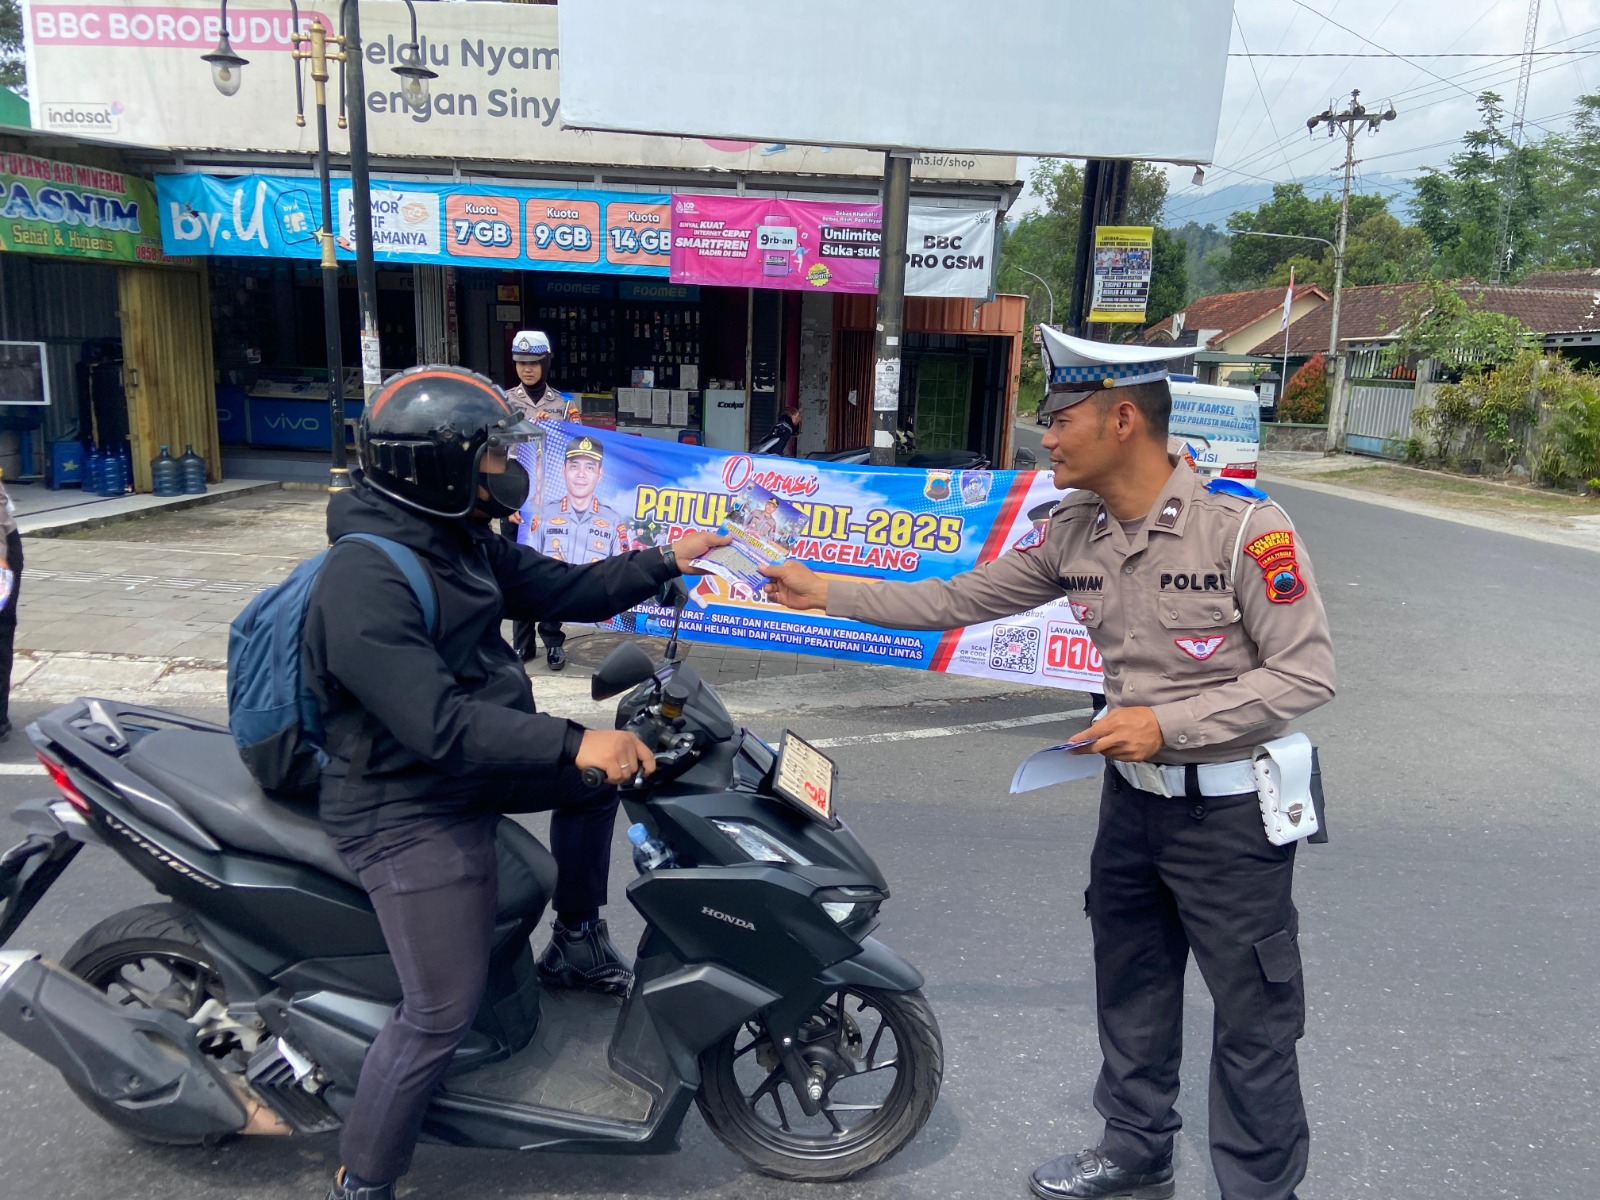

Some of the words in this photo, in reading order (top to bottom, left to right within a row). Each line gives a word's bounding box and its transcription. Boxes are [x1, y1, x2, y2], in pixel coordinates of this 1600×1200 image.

[37, 12, 100, 39] BBC
[361, 34, 449, 66] elalu
[366, 88, 477, 123] engan
[48, 107, 112, 124] indosat
[9, 154, 50, 180] ULANG
[54, 162, 74, 185] AIR
[77, 165, 126, 194] MINERAL
[348, 199, 399, 214] NMOR
[465, 203, 497, 215] Kuota
[547, 207, 579, 219] Kuota
[628, 211, 660, 223] Kuota
[699, 221, 725, 229] KUAT
[13, 224, 48, 246] Sehat
[53, 227, 64, 246] &
[69, 230, 113, 252] Higienis
[349, 230, 428, 246] SAMANYA
[455, 221, 470, 241] 7
[474, 221, 508, 243] GB
[535, 225, 546, 245] 9
[554, 226, 588, 247] GB
[611, 229, 636, 249] 14
[640, 230, 671, 250] GB
[722, 230, 751, 238] CEPAT
[761, 234, 793, 245] 9rb-an
[675, 237, 749, 250] SMARTFREN
[923, 235, 963, 250] BBC
[698, 249, 722, 257] HADIR
[942, 255, 984, 269] GSM
[547, 282, 601, 294] FOOMEE
[633, 286, 687, 297] FOOMEE
[1174, 400, 1197, 411] UNIT
[1197, 402, 1235, 416] KAMSEL
[264, 412, 320, 431] vivo
[1187, 415, 1219, 427] POLRESTA
[1220, 420, 1255, 431] MAGELANG
[589, 528, 611, 539] POLRI
[1248, 532, 1290, 553] POLRESTA
[786, 538, 920, 572] MAGELANG
[1160, 573, 1227, 590] POLRI
[679, 610, 705, 621] URAT
[712, 614, 741, 626] SURAT
[743, 616, 761, 628] DAN
[763, 620, 831, 637] KELENGKAPAN
[833, 629, 892, 644] KENDARAAN
[894, 636, 924, 649] ANDA,
[1050, 626, 1085, 636] LAYANAN
[704, 624, 729, 635] HELM
[731, 628, 746, 637] SNI
[748, 629, 767, 640] DAN
[770, 633, 802, 645] PATUHI
[804, 637, 861, 652] PERATURAN
[863, 644, 886, 655] LALU
[889, 647, 923, 660] LINTAS
[701, 906, 756, 931] HONDA
